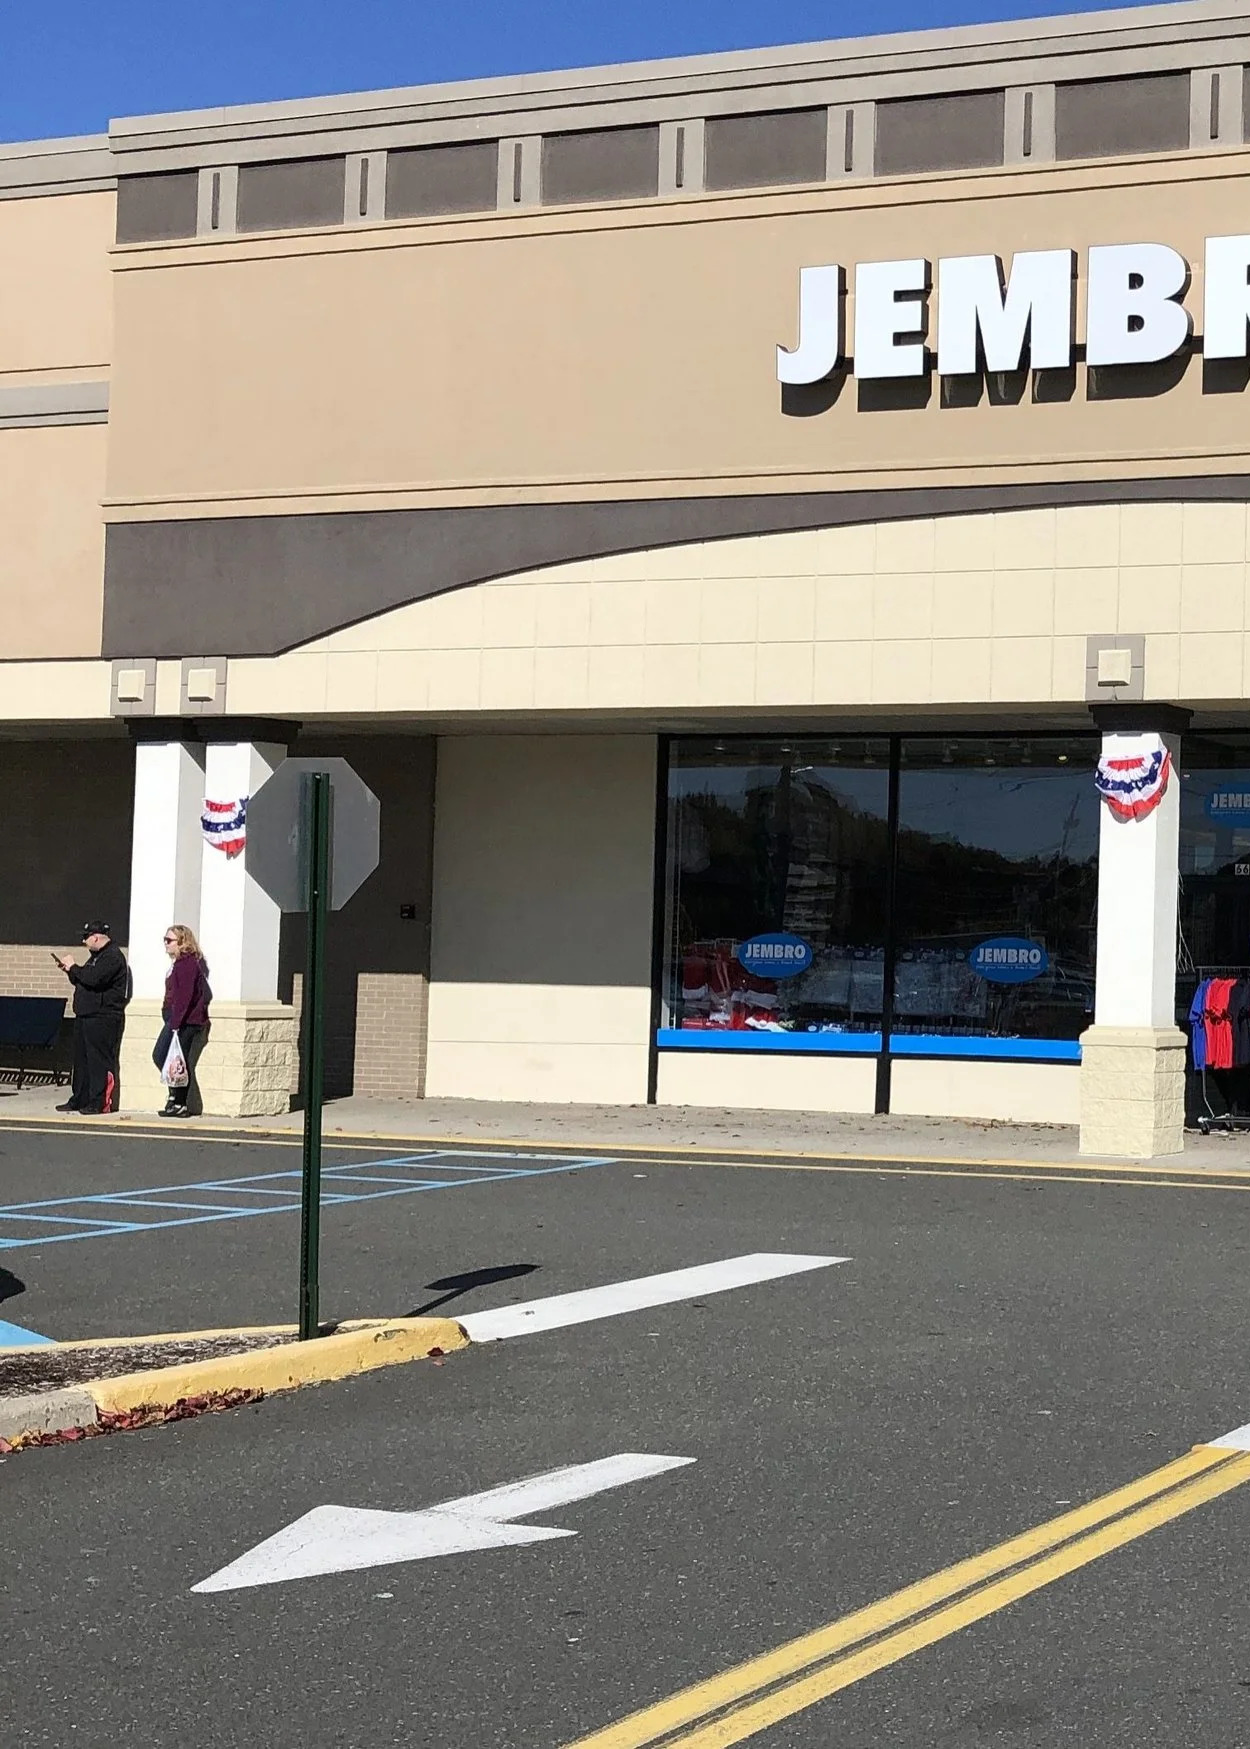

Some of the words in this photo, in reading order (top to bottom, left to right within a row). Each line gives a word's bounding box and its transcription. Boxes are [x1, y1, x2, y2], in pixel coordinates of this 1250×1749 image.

[1236, 864, 1249, 874] 66
[745, 943, 806, 959] JEMBRO
[977, 948, 1041, 963] JEMBRO
